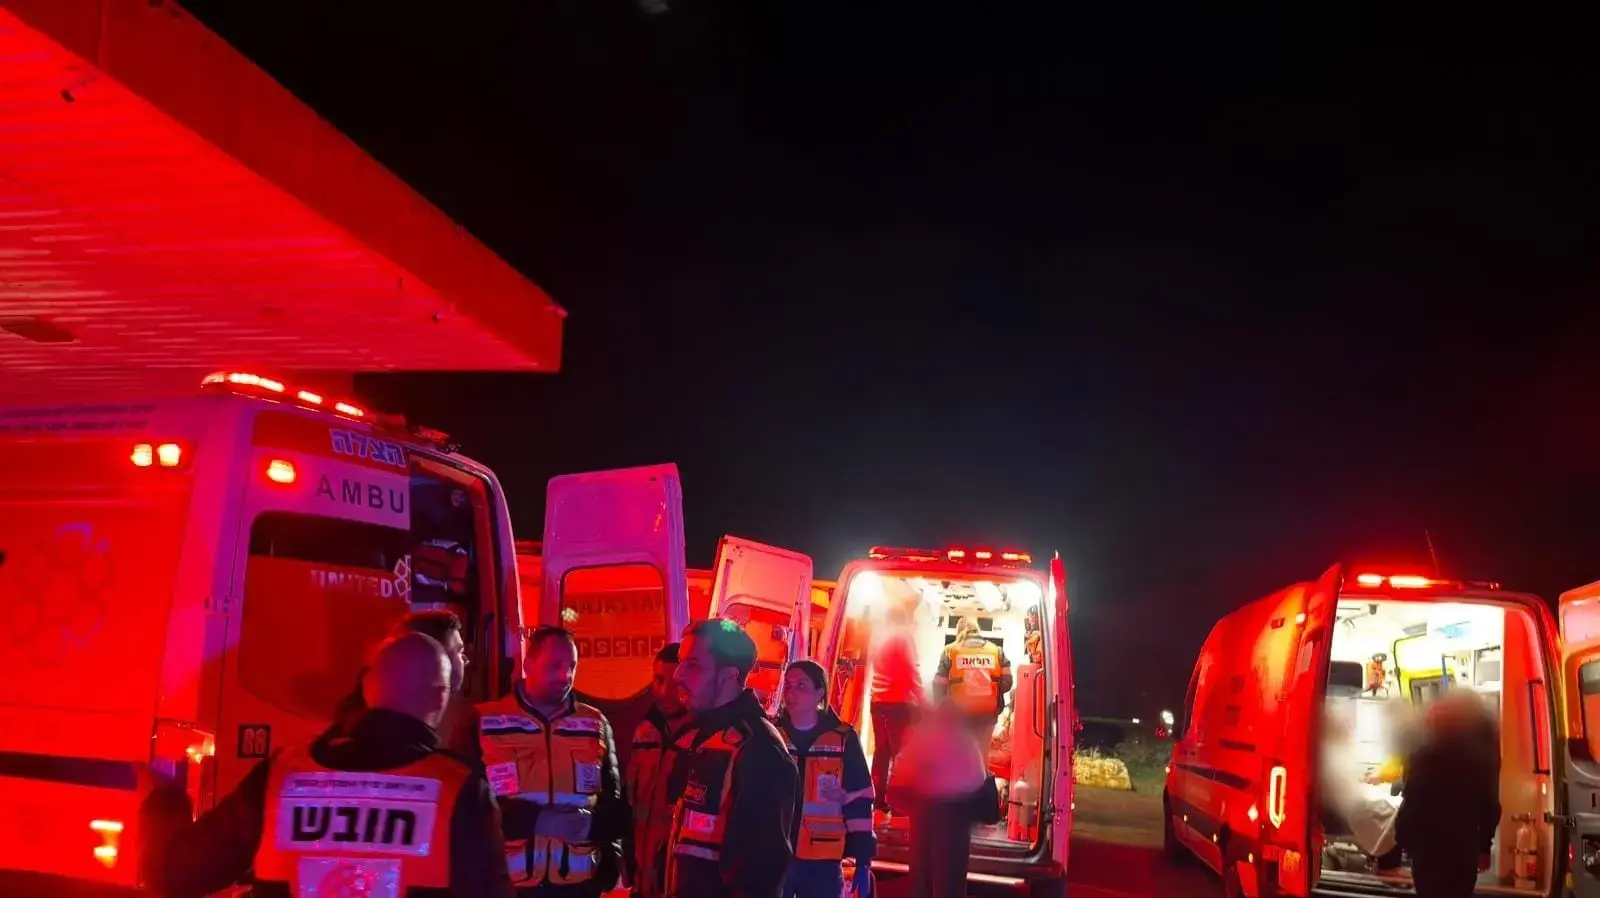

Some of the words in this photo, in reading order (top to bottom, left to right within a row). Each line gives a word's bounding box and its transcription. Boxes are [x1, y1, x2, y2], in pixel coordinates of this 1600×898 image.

[329, 428, 406, 468] הצלה
[316, 474, 404, 514] AMBU
[962, 656, 990, 666] רופאה
[292, 806, 415, 846] חובש
